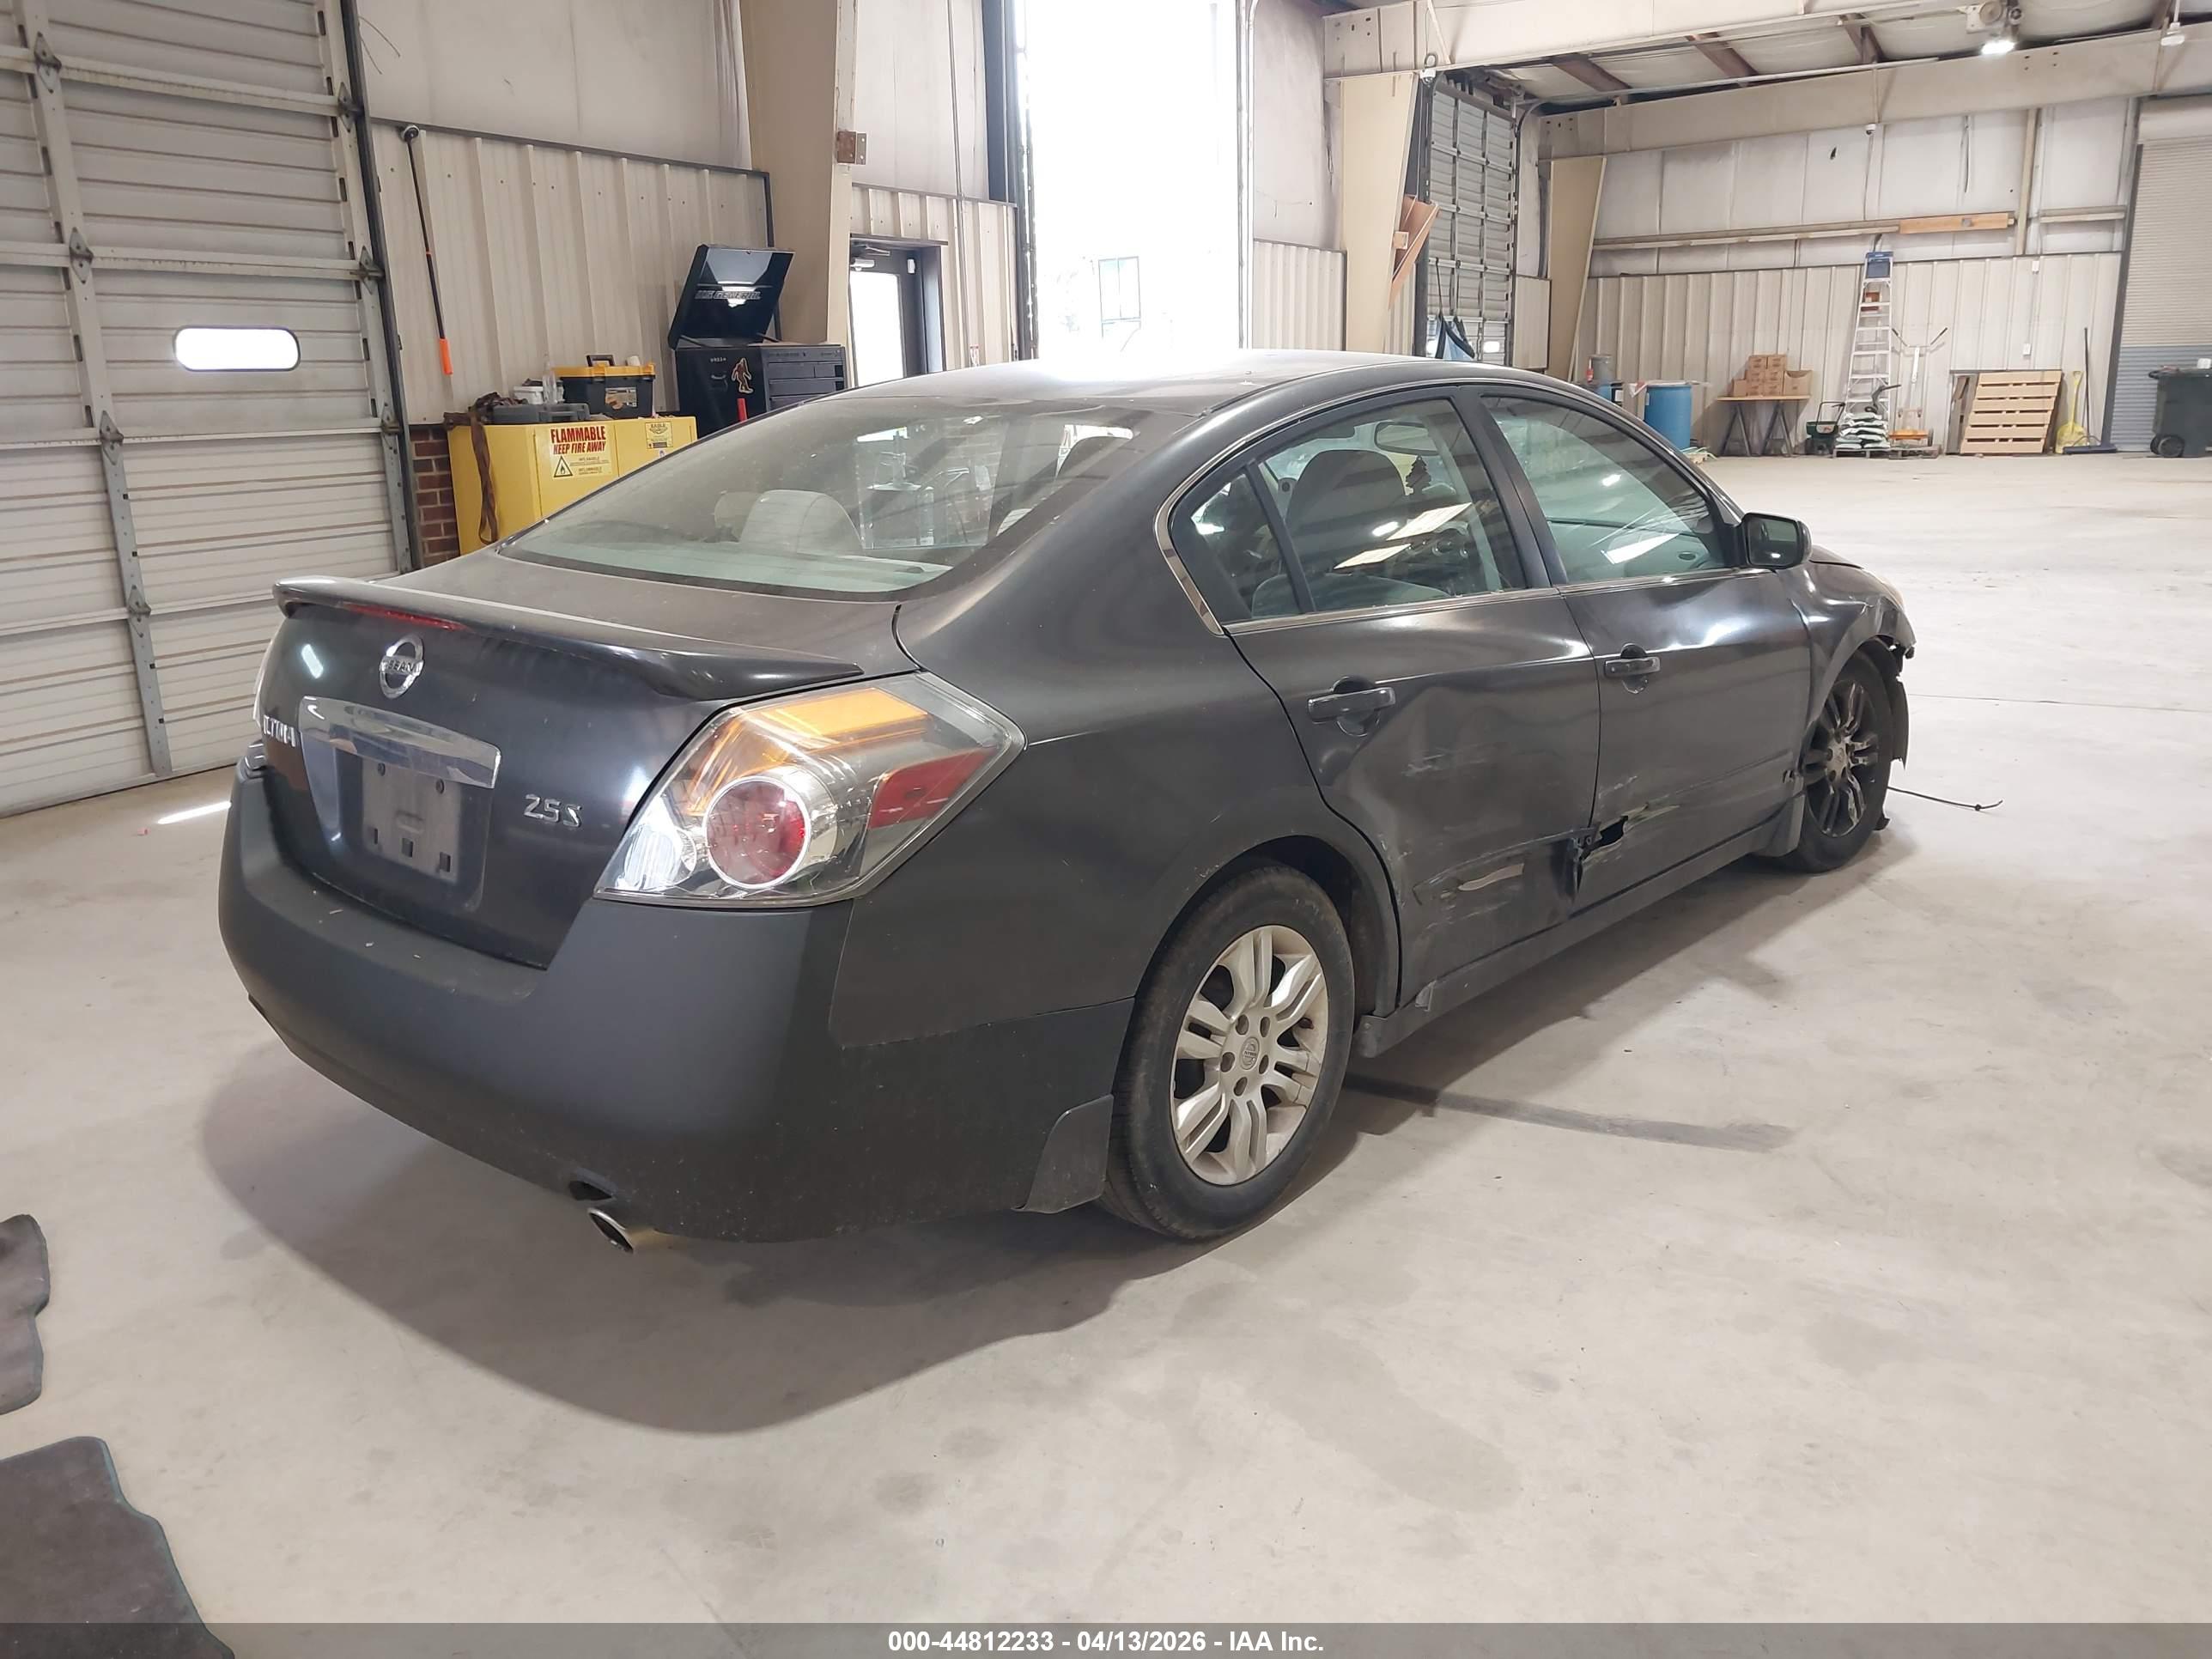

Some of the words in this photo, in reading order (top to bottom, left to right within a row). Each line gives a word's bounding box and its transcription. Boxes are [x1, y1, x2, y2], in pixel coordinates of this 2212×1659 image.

[550, 425, 606, 443] FLAMMABLE
[554, 443, 570, 455] KEEP
[571, 442, 586, 453] FIRE
[586, 441, 606, 453] AWAY
